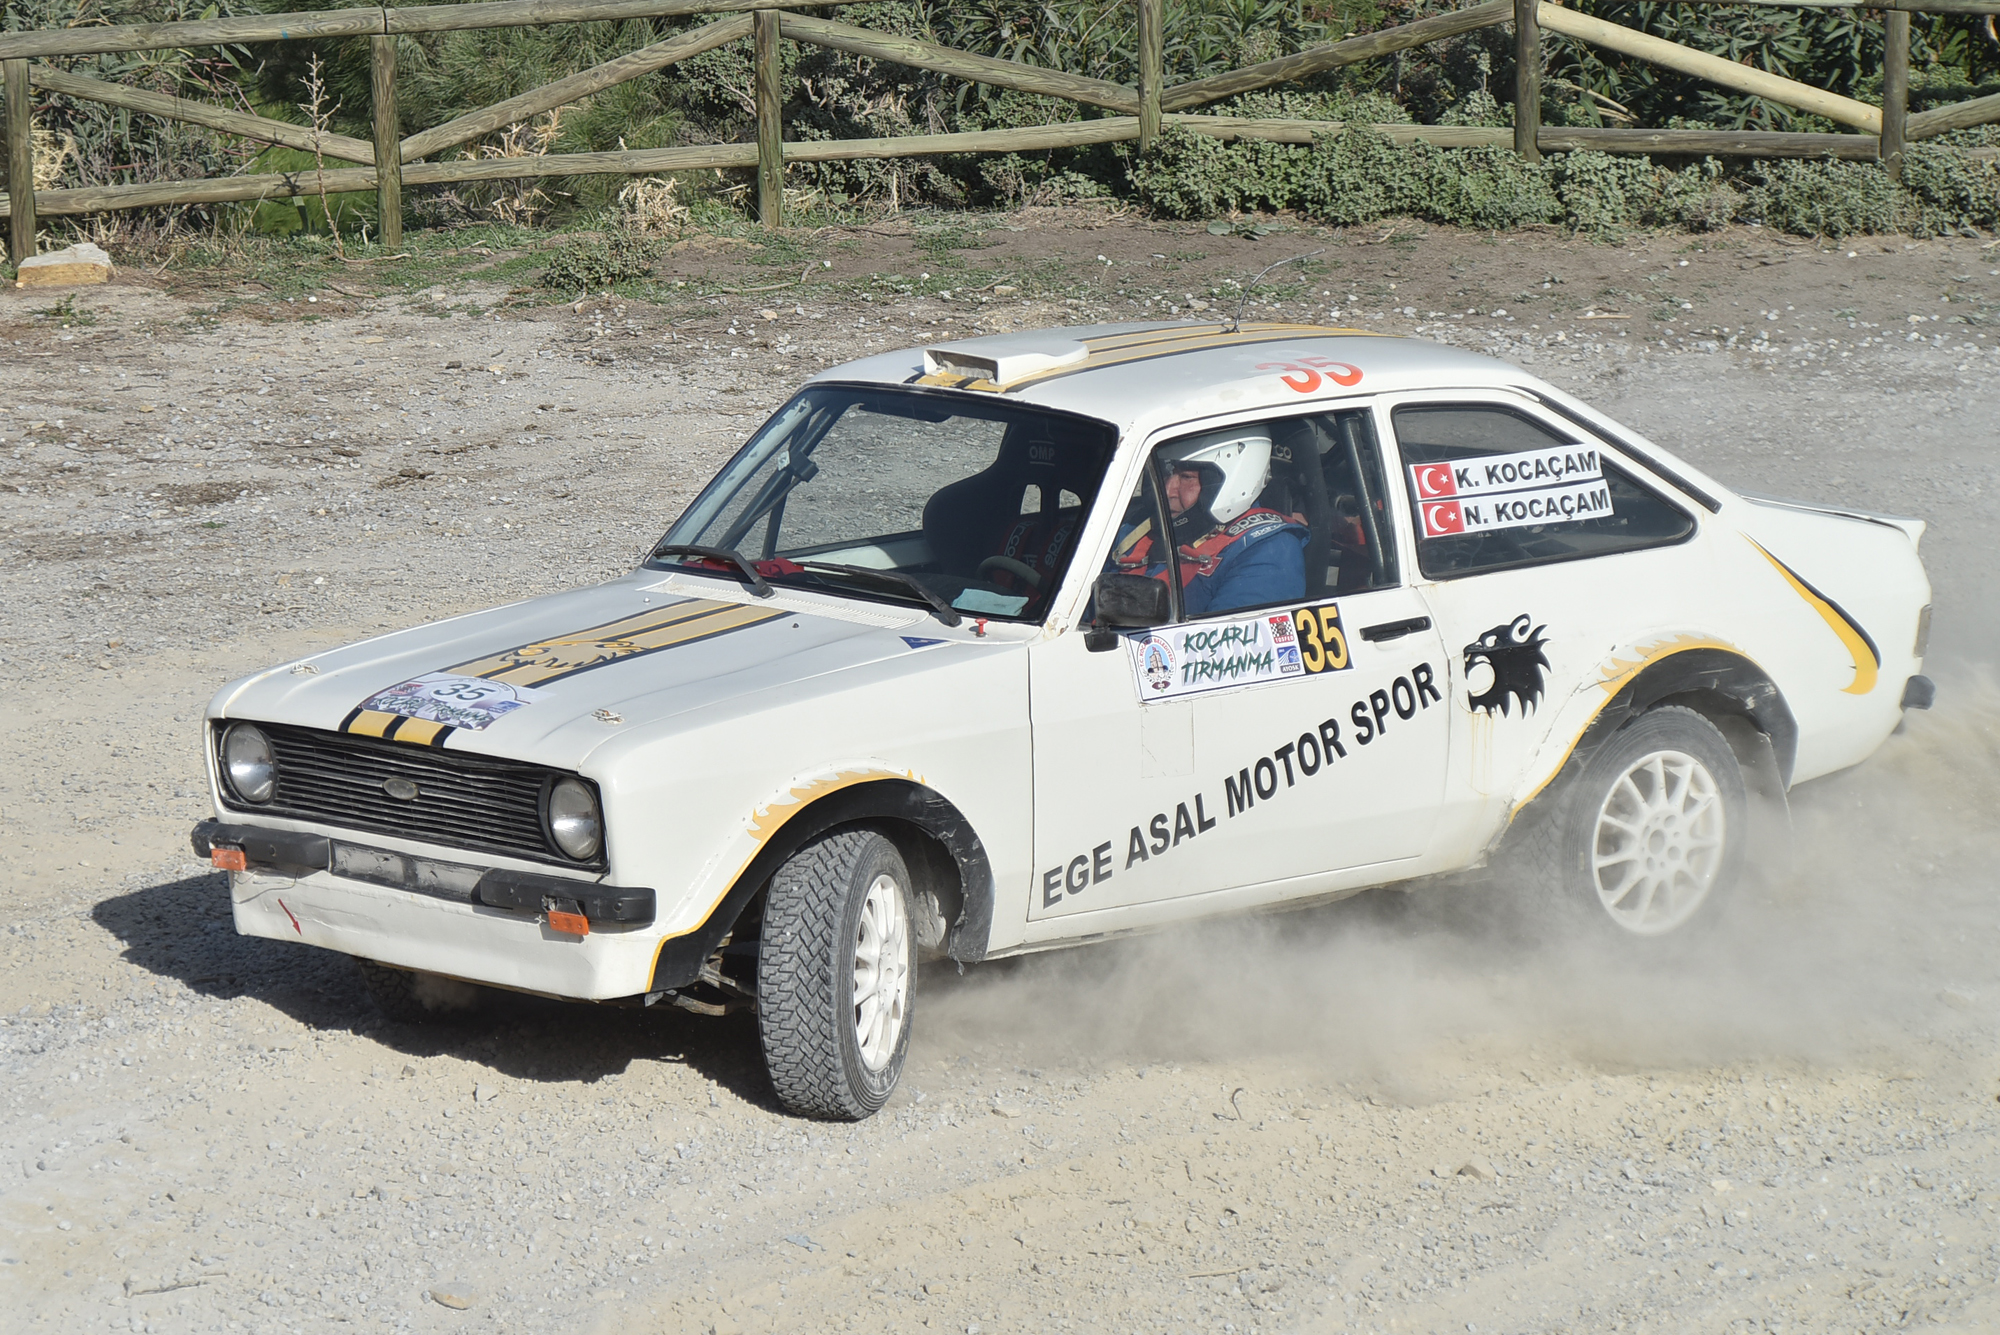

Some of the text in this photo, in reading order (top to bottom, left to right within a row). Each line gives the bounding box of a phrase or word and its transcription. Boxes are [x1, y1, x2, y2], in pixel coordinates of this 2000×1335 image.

[1255, 356, 1364, 393] 35
[1029, 445, 1056, 461] OMP
[1455, 450, 1598, 488] K. KOCAÇAM
[1464, 488, 1609, 526] N. KOCAÇAM
[1183, 620, 1259, 658] KOÇARLI
[1296, 605, 1349, 673] 35
[1181, 647, 1276, 685] TIRMANMA
[433, 683, 497, 701] 35
[1042, 662, 1442, 909] EGE ASAL MOTOR SPOR
